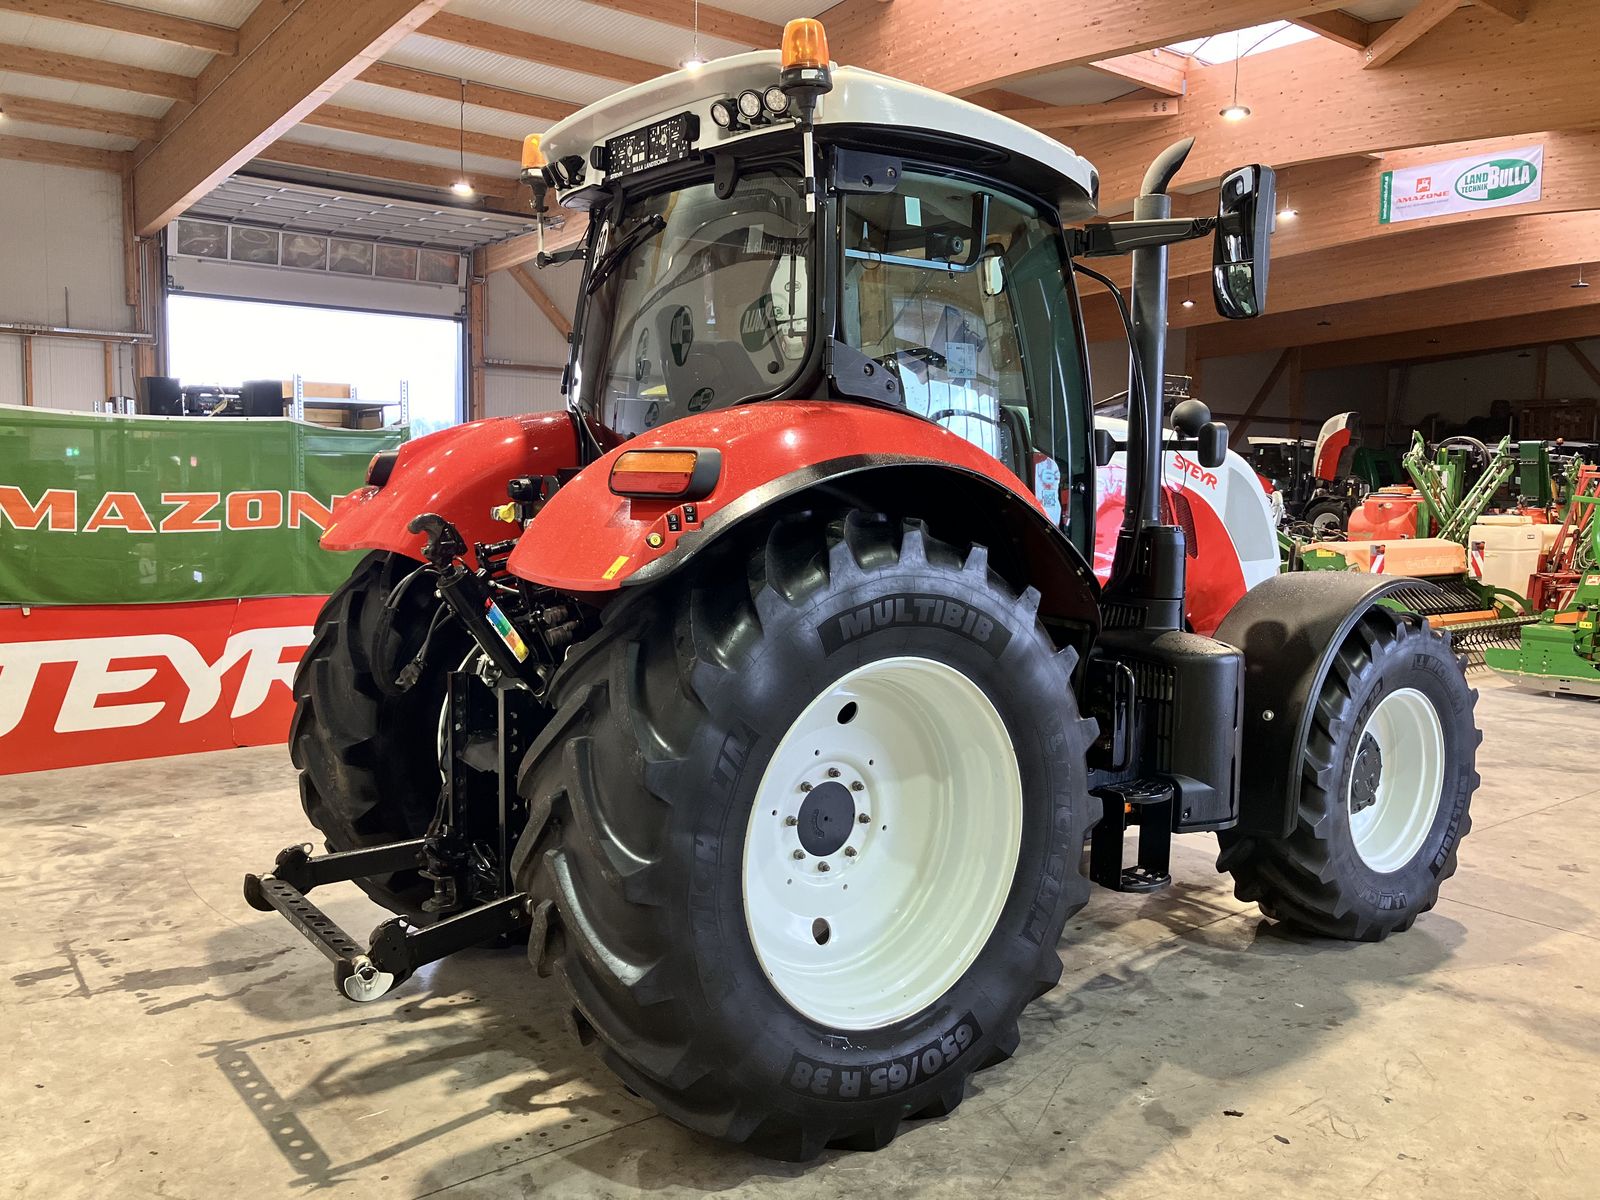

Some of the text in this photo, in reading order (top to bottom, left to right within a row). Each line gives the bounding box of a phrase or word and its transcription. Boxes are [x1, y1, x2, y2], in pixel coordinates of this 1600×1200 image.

[1461, 183, 1488, 194] TECHNIK
[1464, 172, 1489, 185] LAND
[1488, 163, 1531, 190] BULLA
[1395, 190, 1449, 204] AMAZONE
[1173, 454, 1218, 490] STEYR
[0, 485, 346, 533] MAZON
[838, 598, 994, 642] MULTIBIB
[790, 1023, 973, 1098] 650/65 R 38
